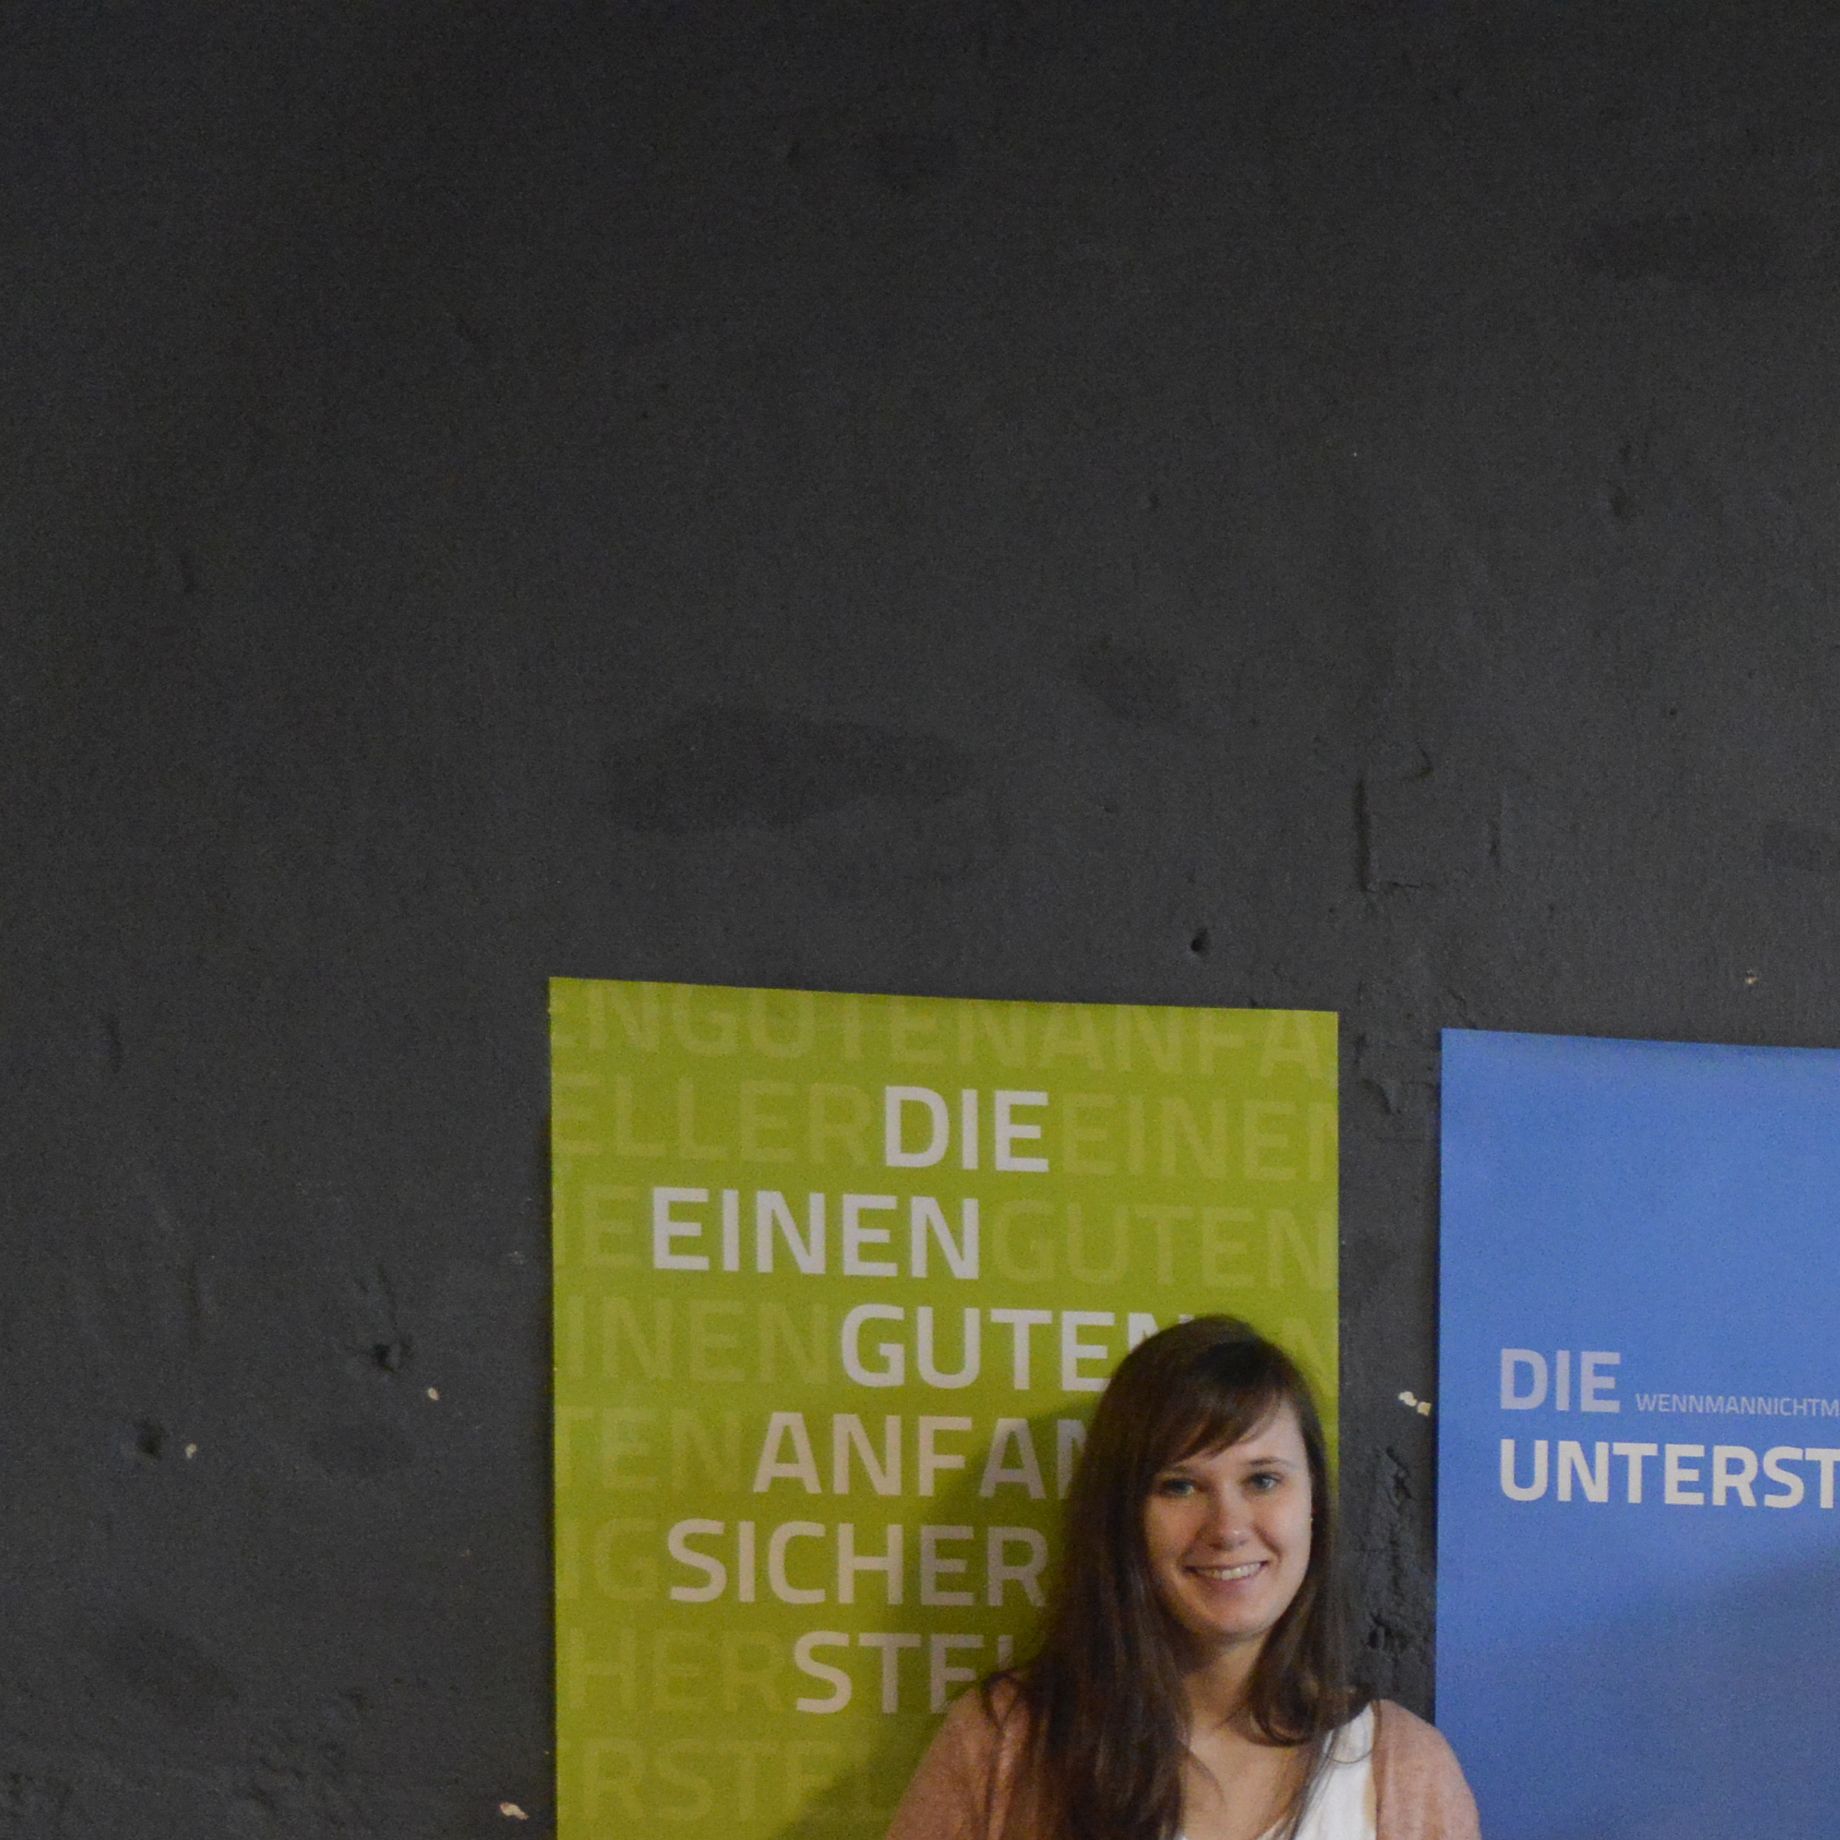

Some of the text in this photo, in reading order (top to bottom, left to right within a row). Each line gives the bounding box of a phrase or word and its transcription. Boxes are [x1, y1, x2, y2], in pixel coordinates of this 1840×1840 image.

[885, 1085, 1048, 1171] DIE
[652, 1187, 980, 1280] EINEN
[842, 1304, 1193, 1392] GUTE
[1501, 1348, 1620, 1414] DIE
[667, 1518, 1047, 1606] SICHER
